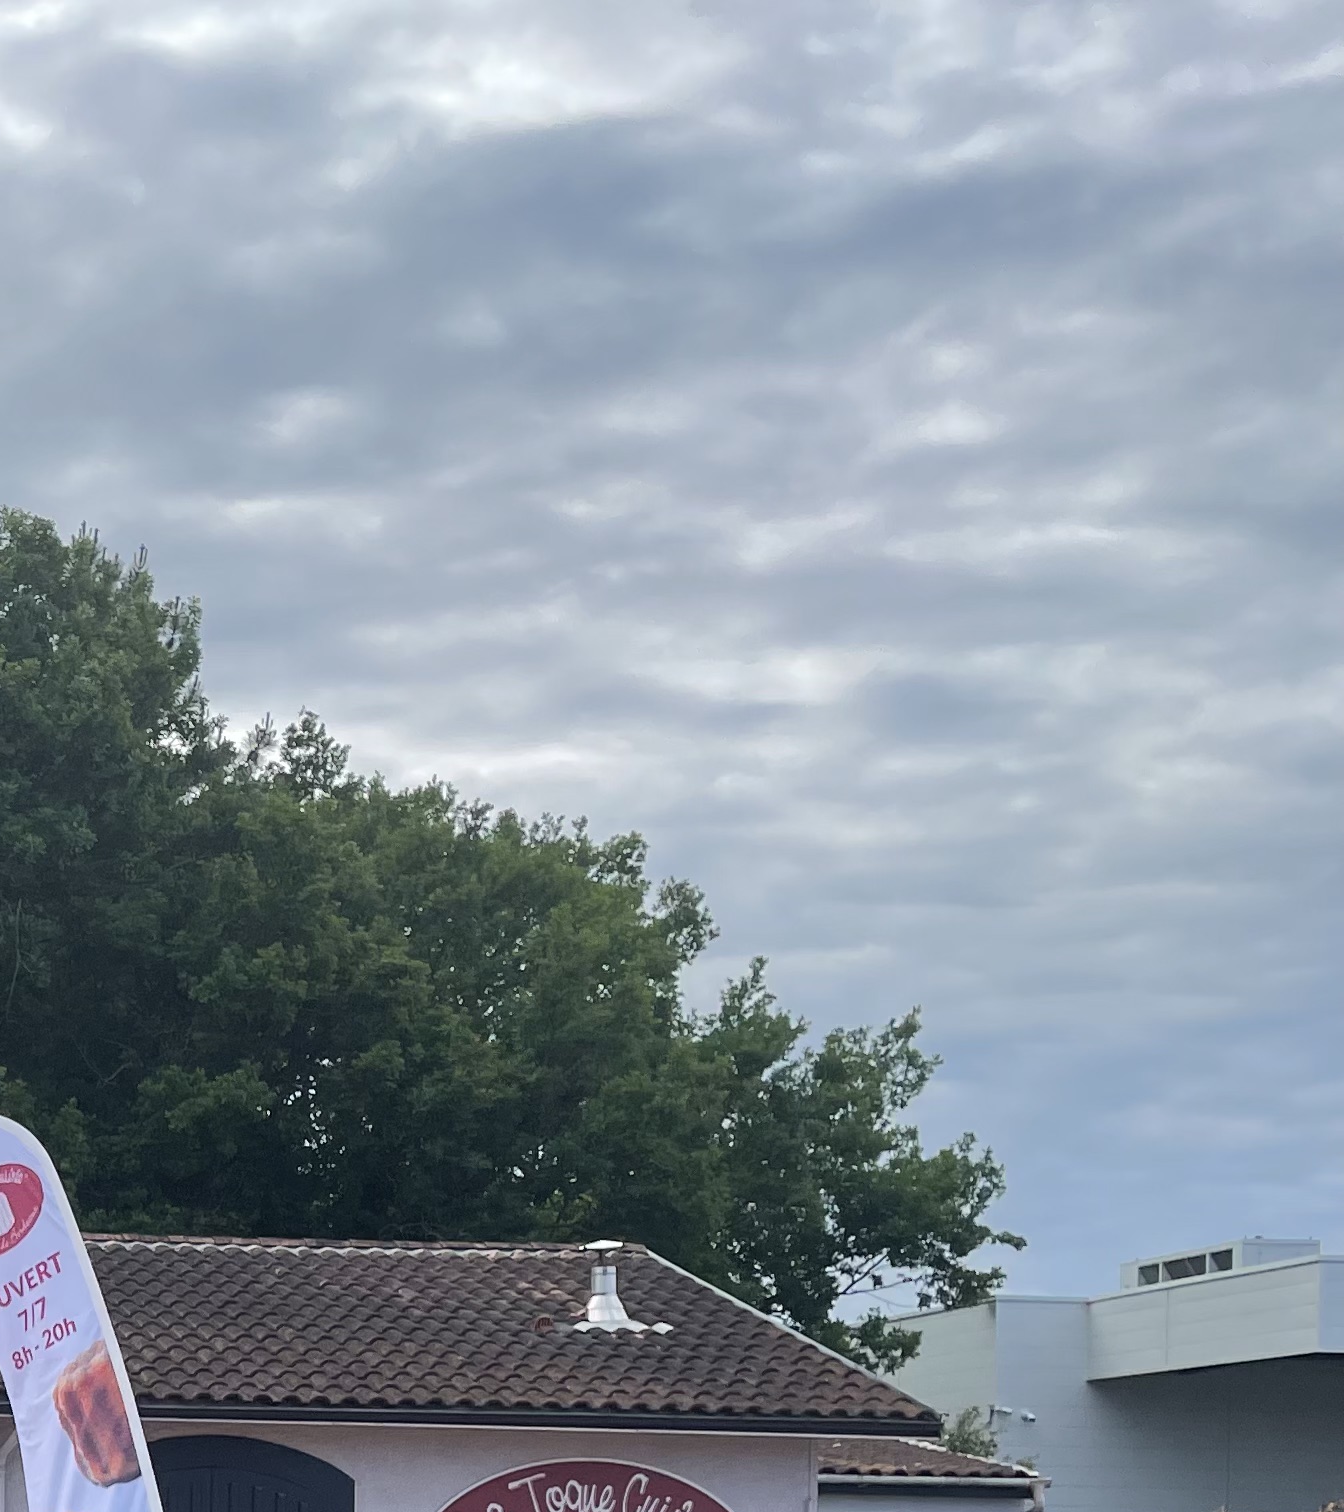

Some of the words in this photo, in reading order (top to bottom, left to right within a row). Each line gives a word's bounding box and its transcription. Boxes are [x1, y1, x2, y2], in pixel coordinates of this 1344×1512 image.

[17, 1296, 46, 1332] 7/7
[12, 1346, 34, 1370] 8h
[42, 1318, 77, 1350] 20h
